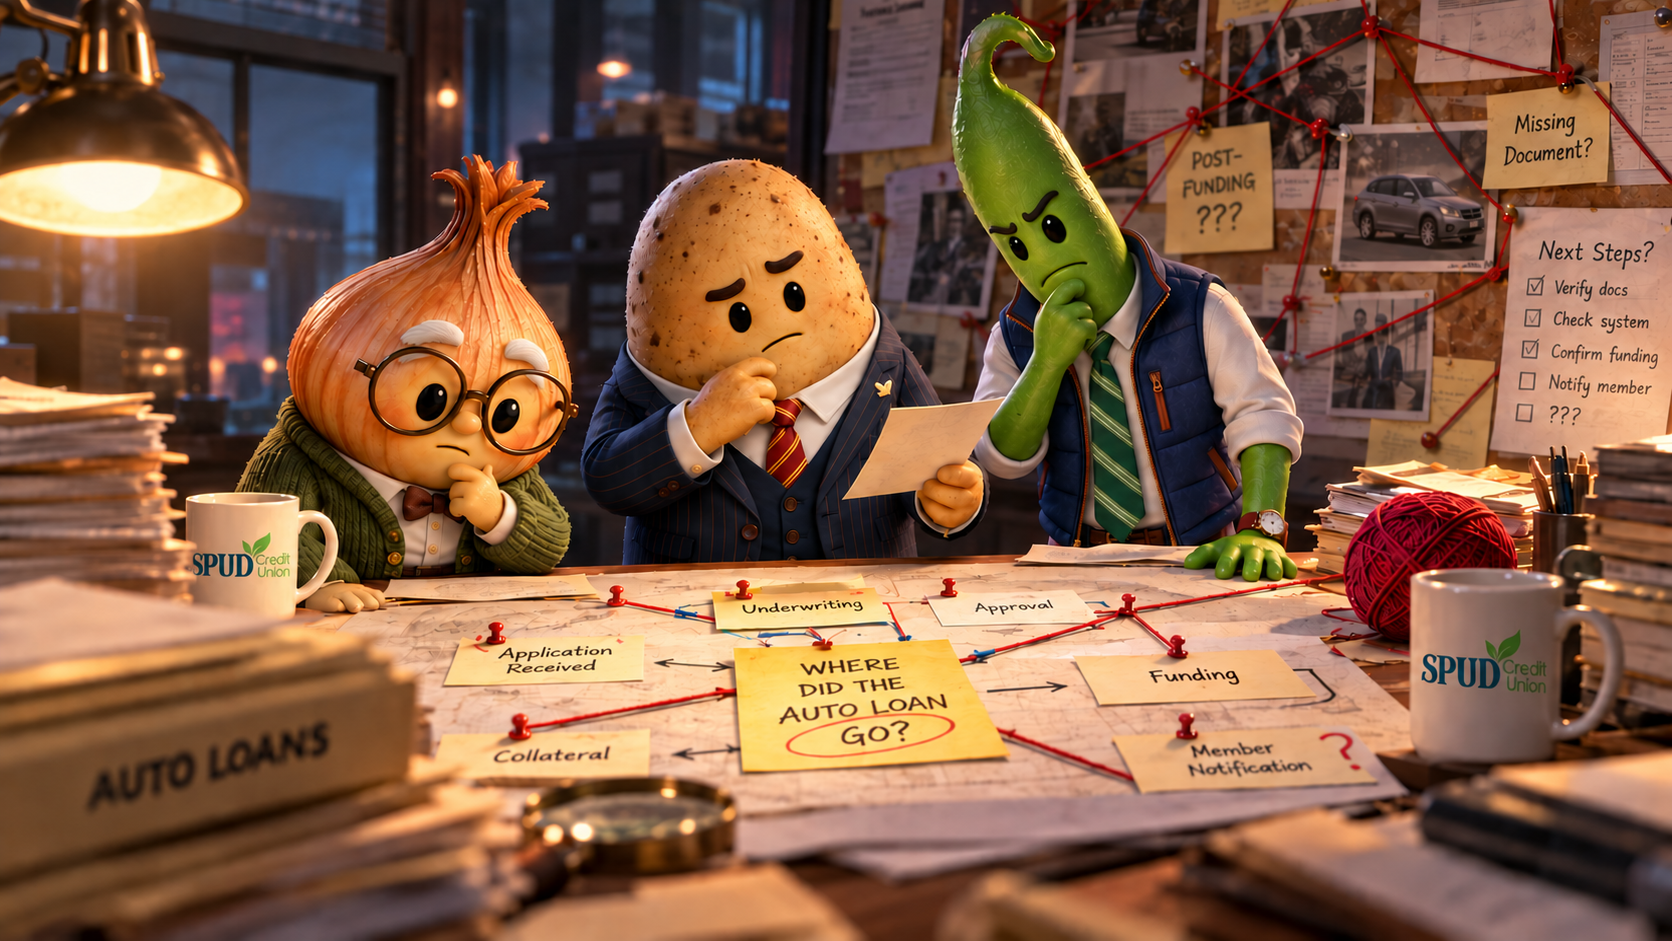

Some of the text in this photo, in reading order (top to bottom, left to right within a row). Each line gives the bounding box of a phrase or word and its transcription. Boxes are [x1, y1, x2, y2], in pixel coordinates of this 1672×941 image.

[1514, 113, 1576, 137] Missing
[1192, 148, 1243, 170] POST-
[1503, 137, 1594, 166] Document?
[1183, 172, 1256, 198] FUNDING
[1197, 201, 1243, 234] ???
[1538, 240, 1655, 270] Next Steps?
[1554, 279, 1628, 302] Verify docs
[1553, 311, 1649, 334] Check system
[1551, 344, 1658, 370] Confirm funding
[1548, 374, 1652, 398] Notify member
[1549, 405, 1582, 426] ???
[192, 552, 254, 578] SPUD
[255, 552, 291, 566] Credit
[257, 566, 291, 578] Union
[741, 598, 864, 615] Underwriting
[974, 600, 1055, 615] Approval
[498, 645, 613, 663] Application
[506, 659, 597, 674] Received
[800, 657, 901, 676] WHERE
[1148, 667, 1240, 686] Funding
[1421, 653, 1501, 690] SPUD
[1502, 659, 1547, 677] Credit
[798, 676, 905, 698] DID THE
[1506, 676, 1547, 694] Union
[779, 693, 948, 725] AUTO LOAN
[840, 720, 910, 747] GO?
[493, 746, 611, 764] Collateral
[1190, 742, 1274, 759] Member
[86, 721, 330, 814] AUTO LOANS
[1188, 759, 1312, 778] Notification
